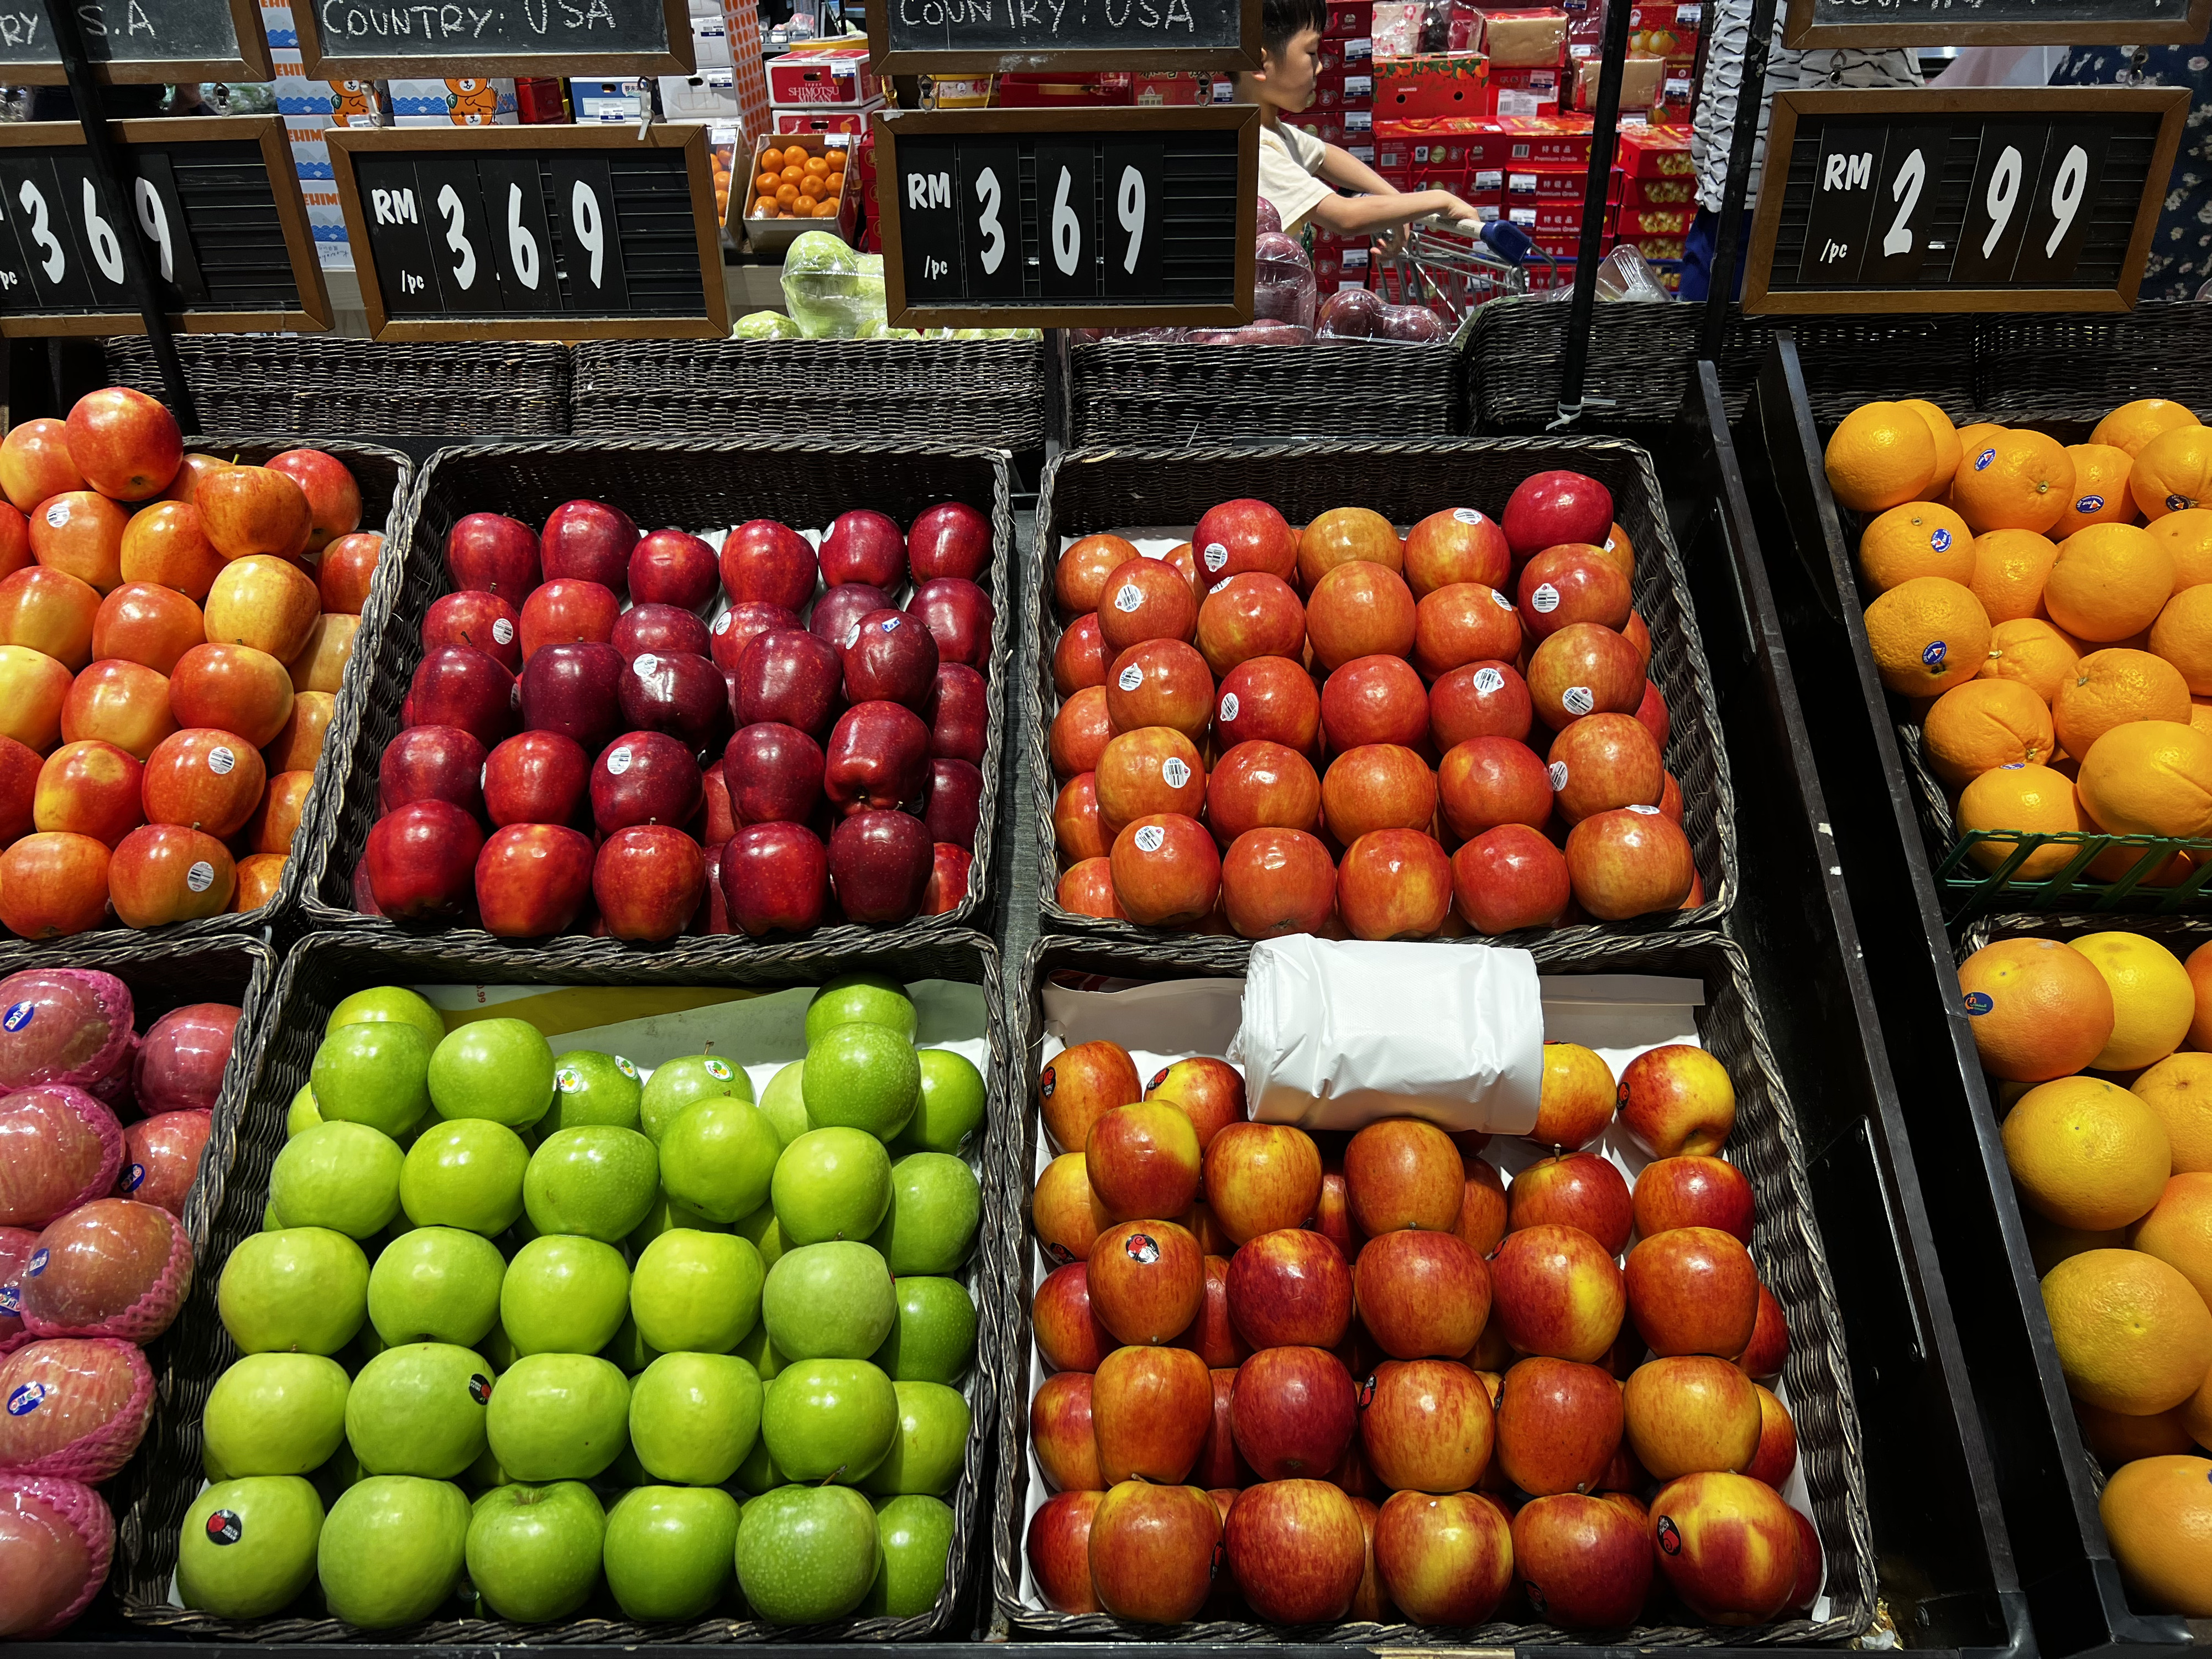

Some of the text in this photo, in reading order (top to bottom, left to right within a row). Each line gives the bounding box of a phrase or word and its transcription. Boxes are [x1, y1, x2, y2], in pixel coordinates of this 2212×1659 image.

[524, 0, 616, 34] USA
[788, 86, 839, 96] SHIMOTSU
[1824, 152, 1872, 191] RM
[908, 172, 950, 209] RM
[372, 188, 418, 225] RM
[1820, 239, 1848, 264] /pc
[402, 270, 425, 294] /pc
[925, 255, 948, 280] /pc
